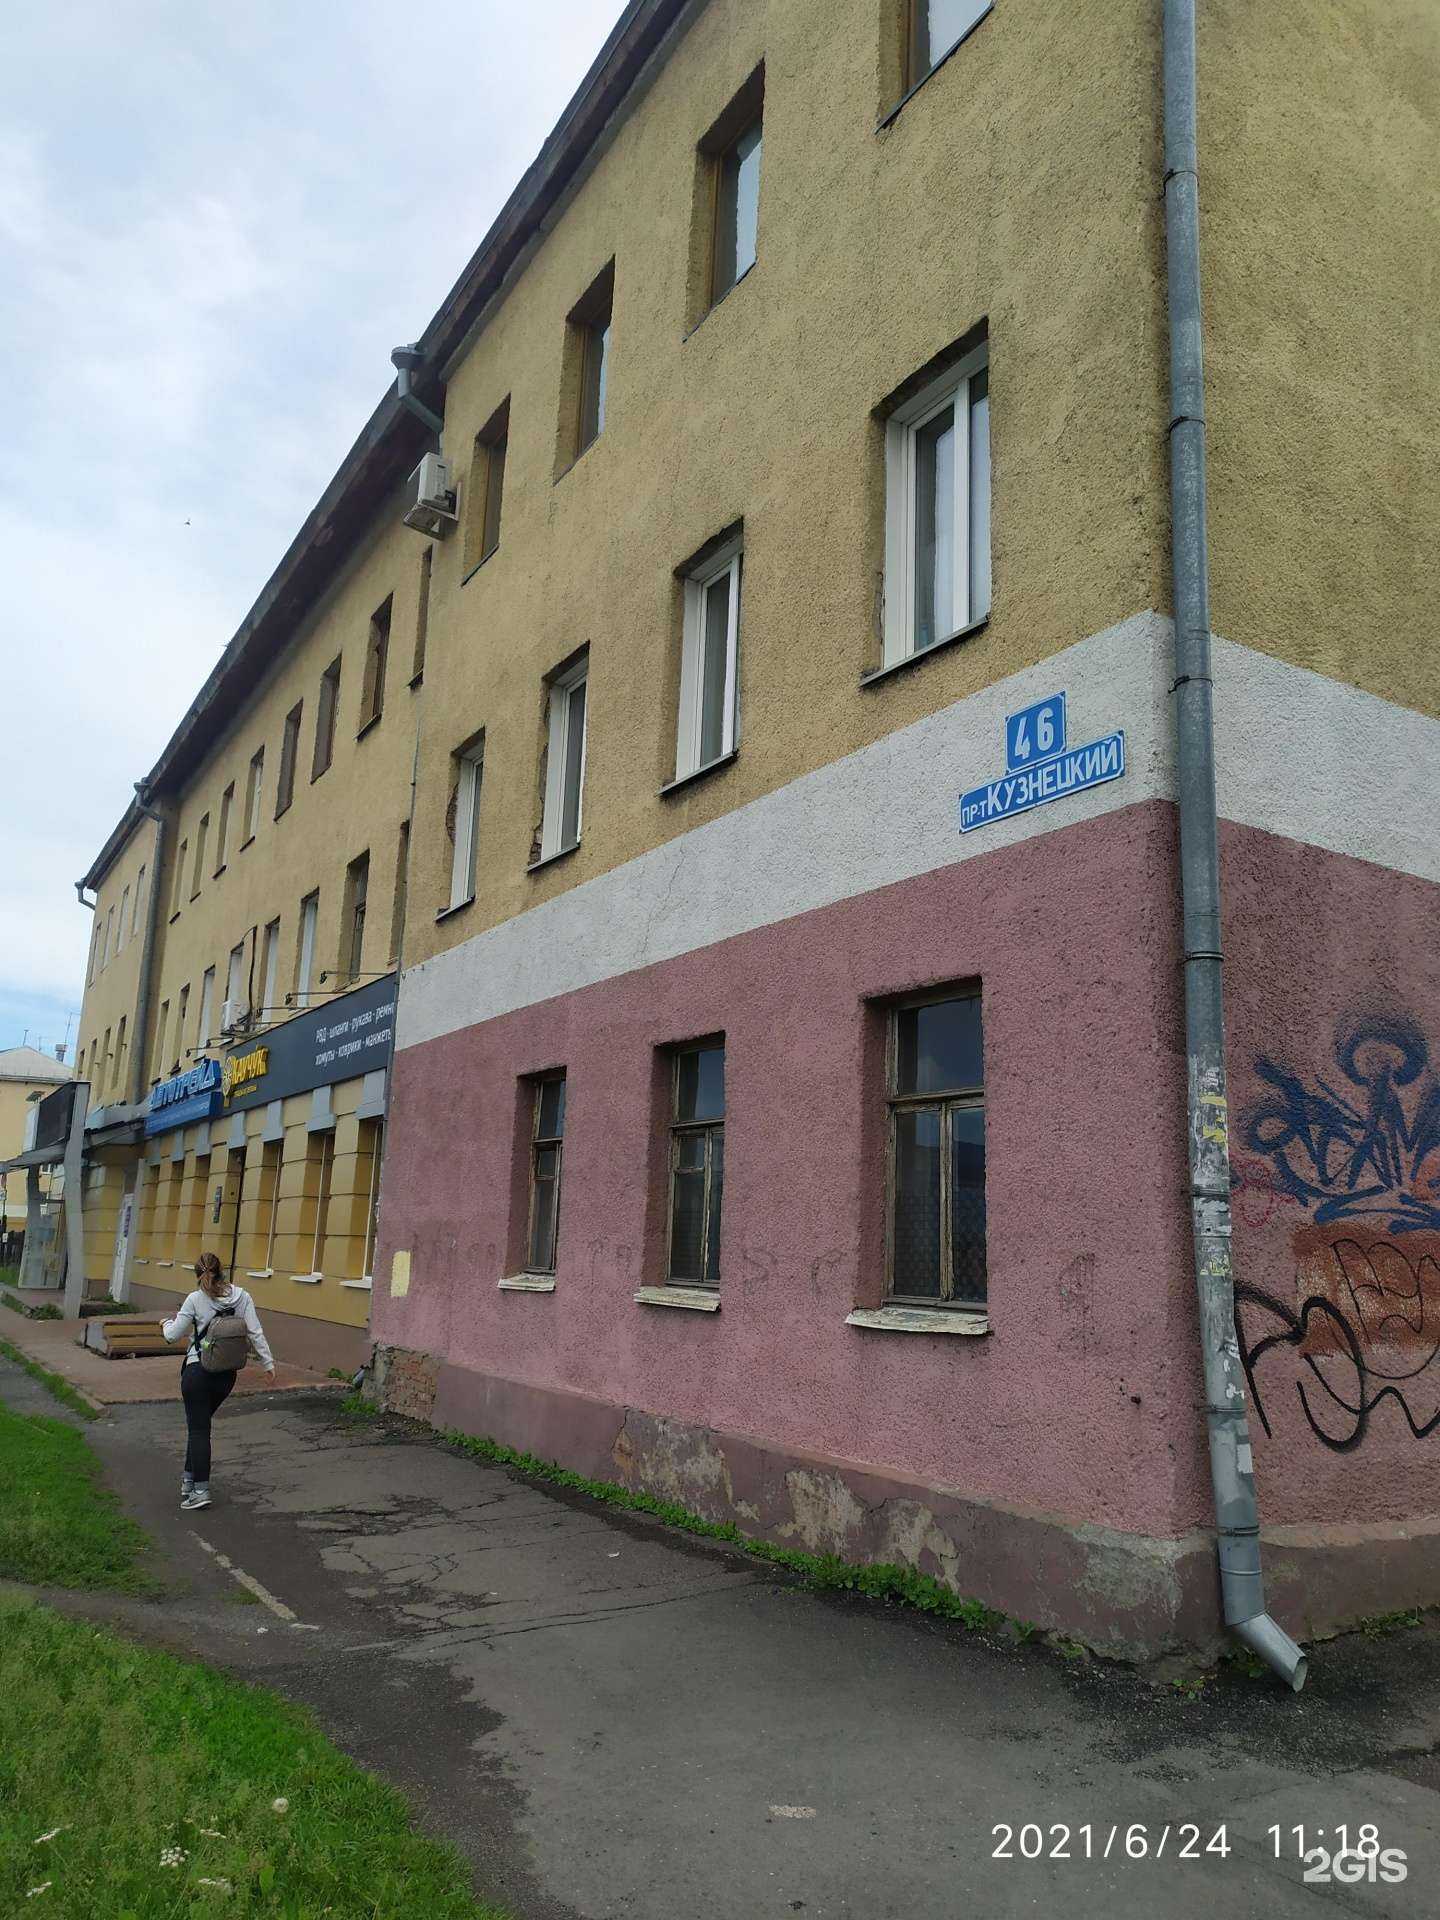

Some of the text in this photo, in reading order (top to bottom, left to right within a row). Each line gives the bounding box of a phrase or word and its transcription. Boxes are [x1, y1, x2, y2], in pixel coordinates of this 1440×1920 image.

[1014, 707, 1054, 760] 46
[987, 738, 1118, 816] КУЗНЕЦКИЙ
[329, 1021, 349, 1039] шланги
[351, 1011, 372, 1032] рукава
[338, 1039, 362, 1060] коврики
